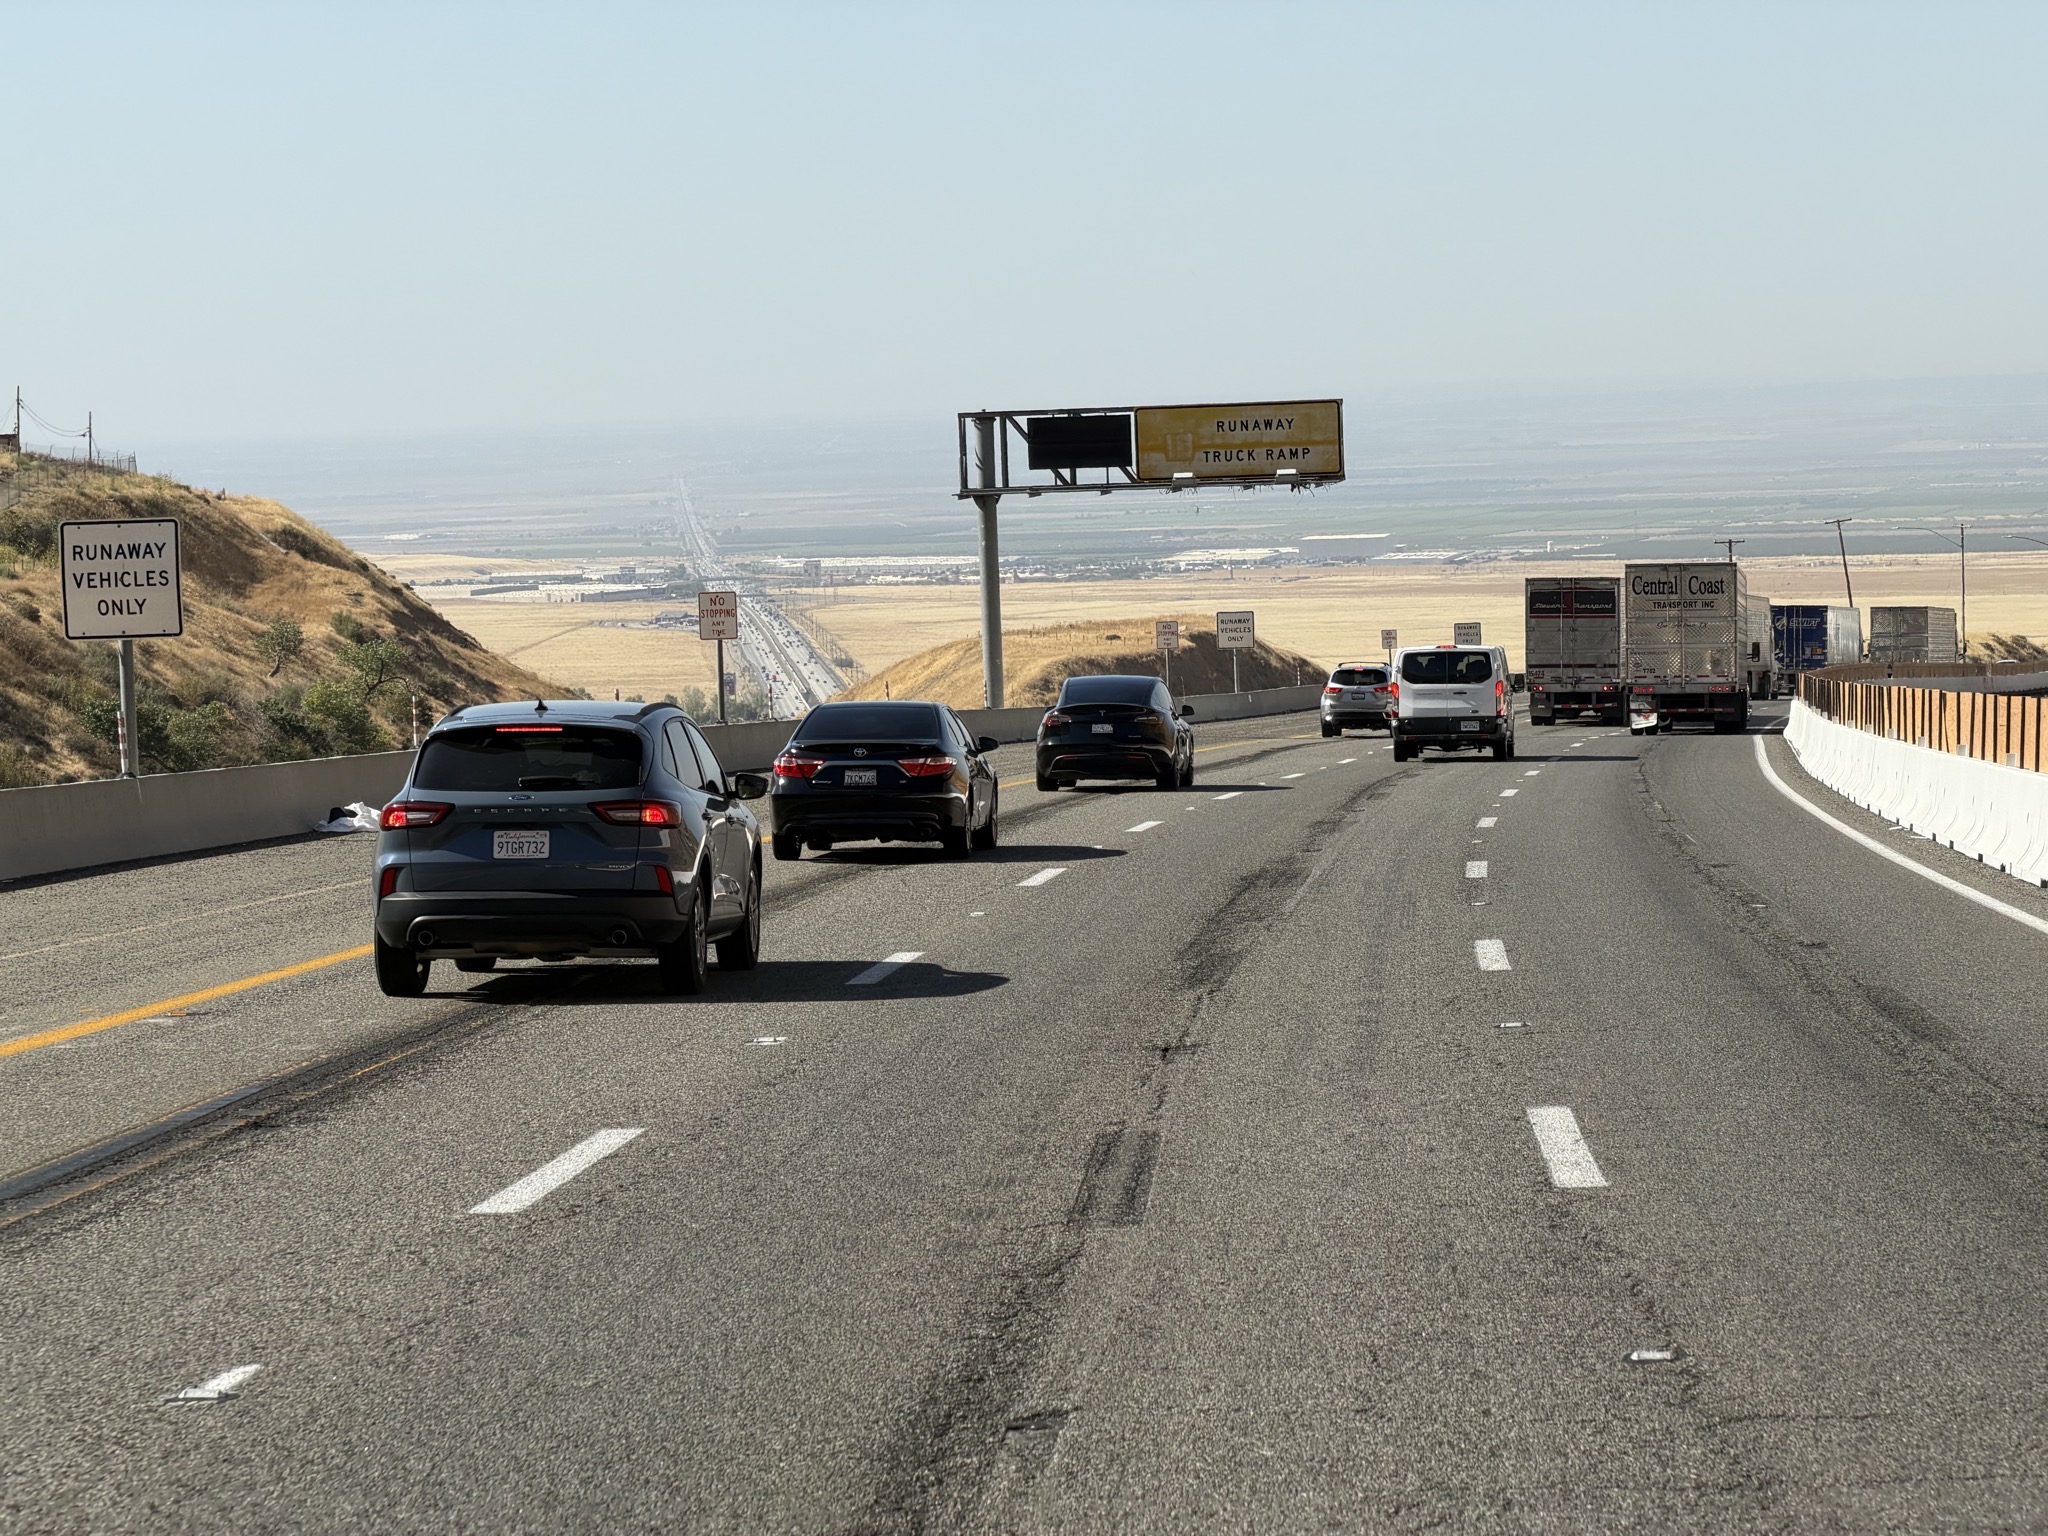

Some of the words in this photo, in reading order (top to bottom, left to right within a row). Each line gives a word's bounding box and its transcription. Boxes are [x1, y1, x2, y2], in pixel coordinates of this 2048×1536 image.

[1216, 418, 1294, 432] RUNAWAY
[1203, 449, 1255, 462] TRUCK
[1266, 448, 1311, 461] RAMP
[72, 542, 167, 561] RUNAWAY
[73, 570, 169, 589] VEHICLES
[1632, 575, 1678, 595] Central
[1688, 576, 1725, 595] Coast
[97, 598, 147, 616] ONLY
[710, 597, 725, 606] NO
[1653, 601, 1698, 609] TRANSPORT
[701, 609, 736, 618] STOPPING
[1790, 618, 1821, 626] SWIFT
[497, 841, 546, 854] 9TGR732
